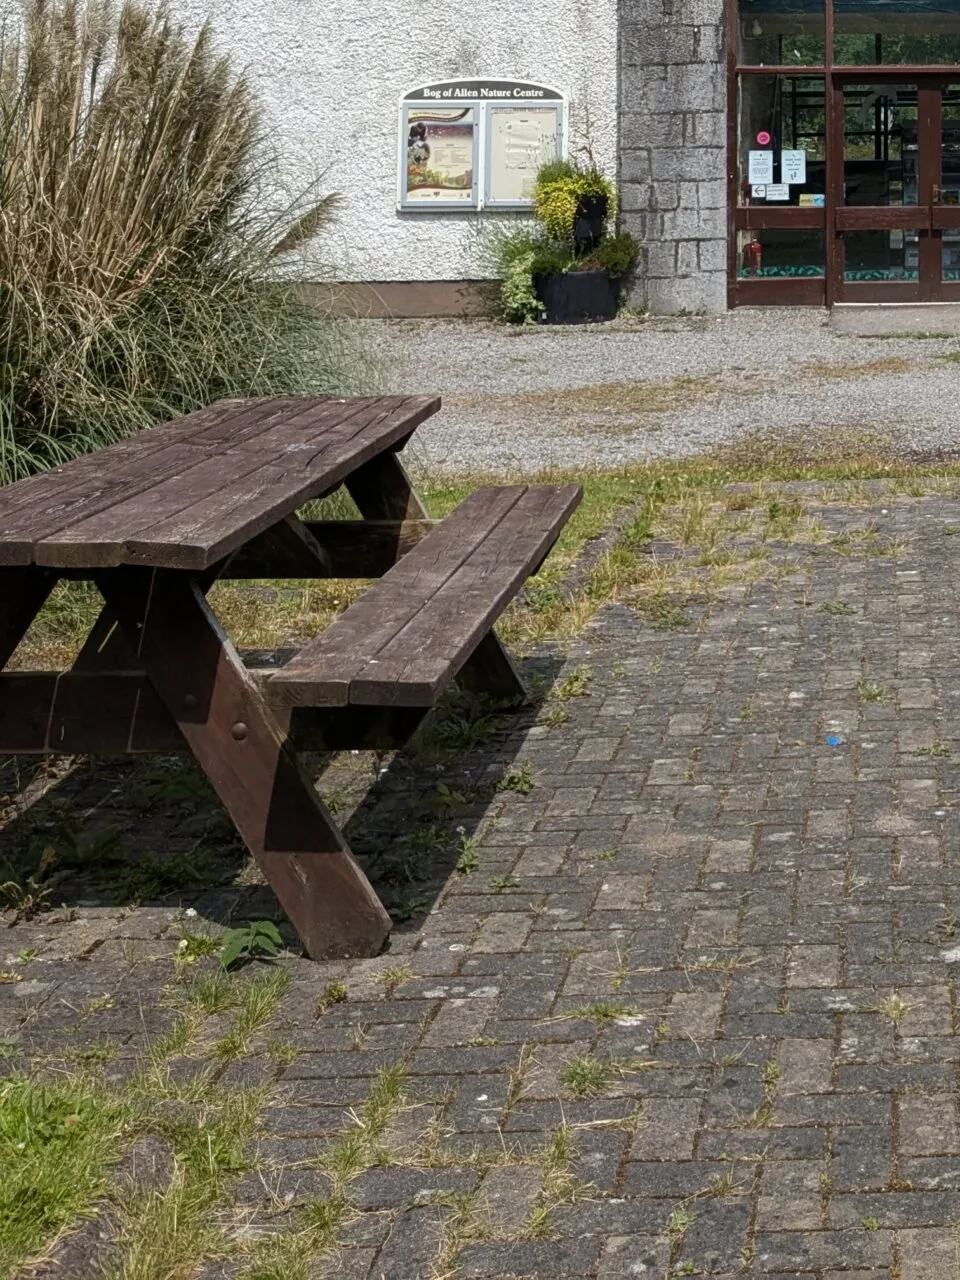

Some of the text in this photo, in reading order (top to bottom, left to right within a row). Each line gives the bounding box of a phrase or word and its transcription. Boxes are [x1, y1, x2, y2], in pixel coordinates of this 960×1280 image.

[423, 88, 544, 99] Bog of Allen Nature Centre
